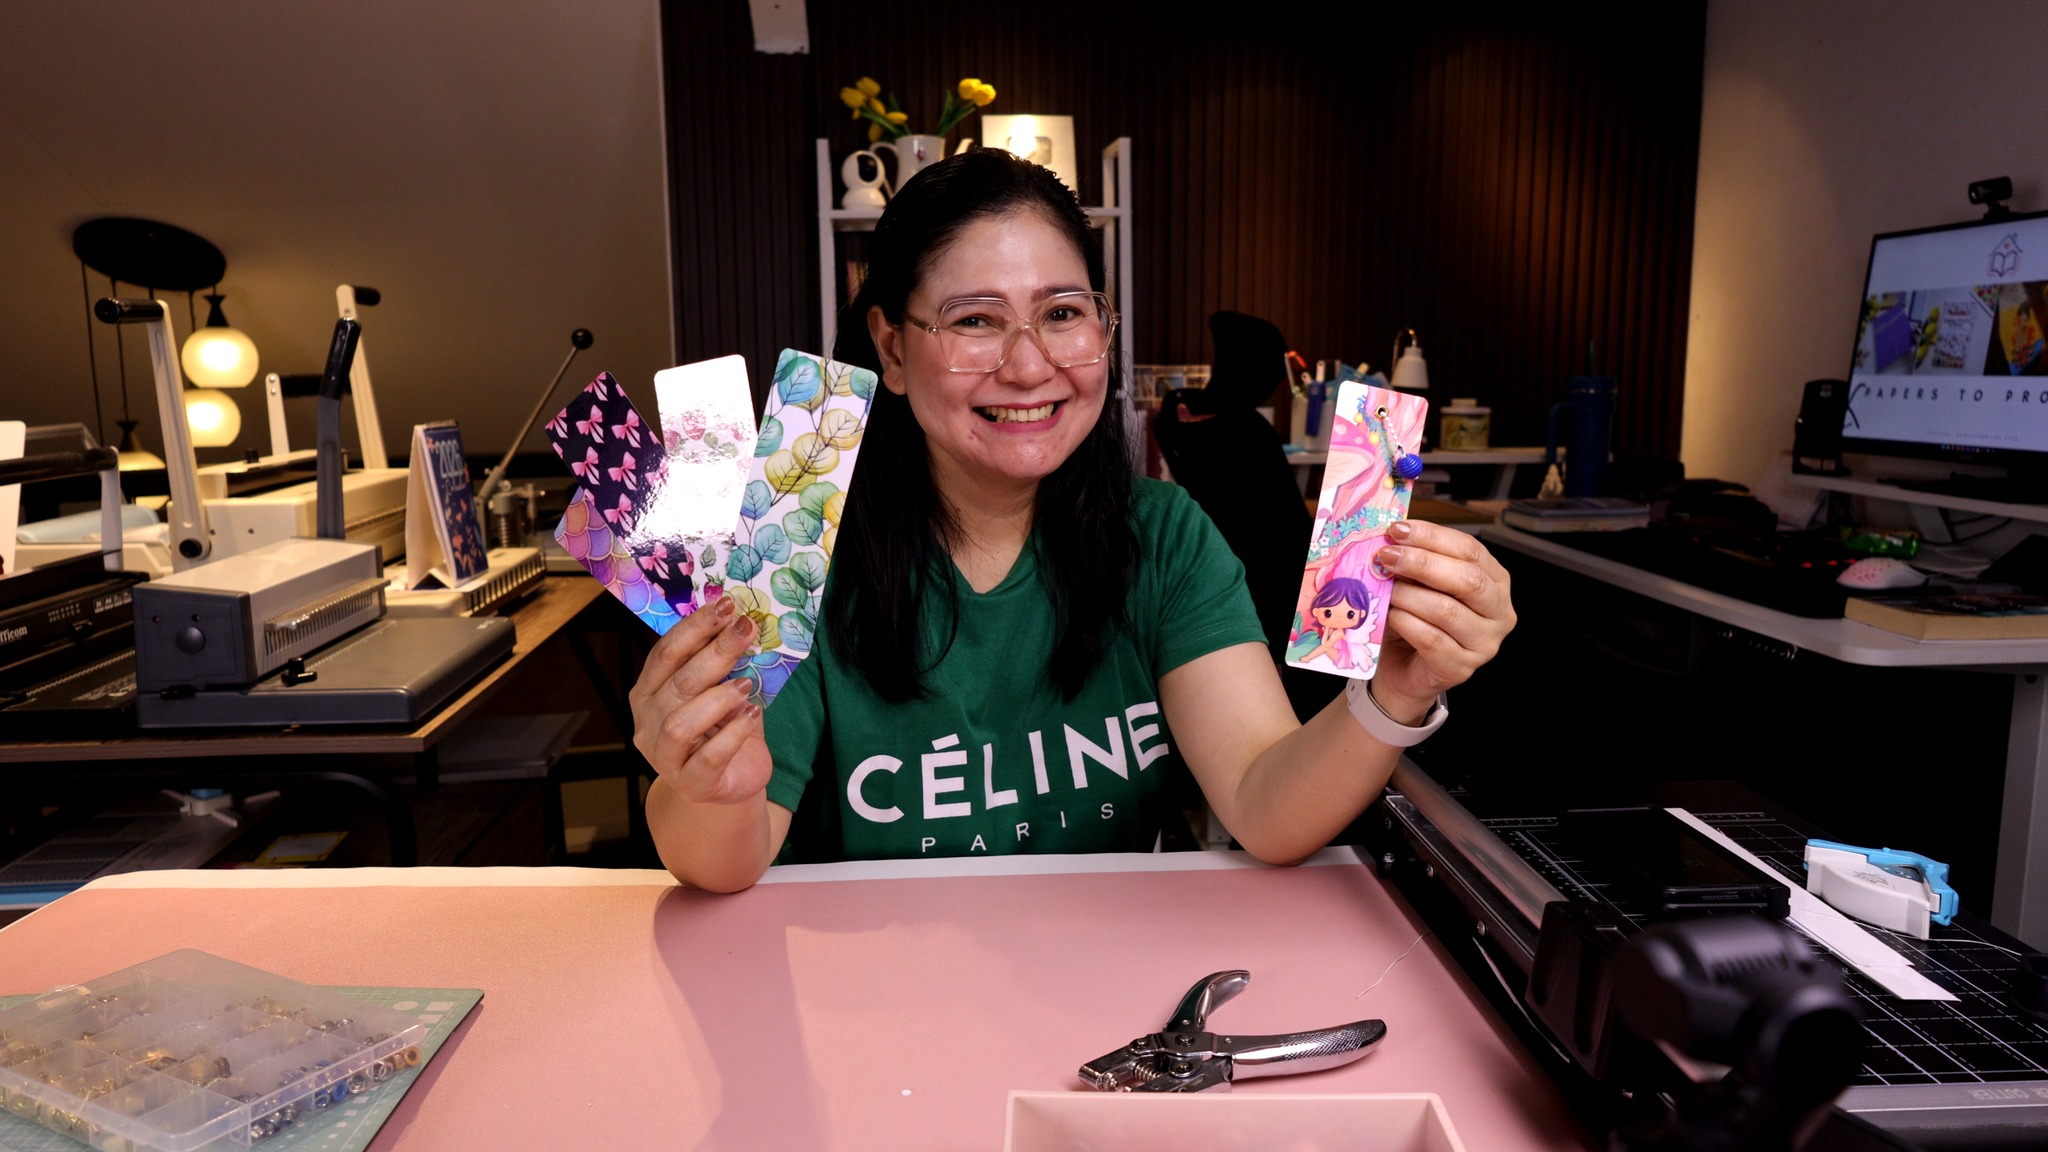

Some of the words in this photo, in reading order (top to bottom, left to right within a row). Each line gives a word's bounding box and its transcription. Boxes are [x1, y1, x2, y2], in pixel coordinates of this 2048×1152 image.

[1865, 387, 1938, 400] PAPERS
[1959, 388, 1984, 402] TO
[2005, 389, 2048, 404] PRO
[846, 701, 1170, 823] CÉLINE
[921, 803, 1114, 852] PARIS
[1967, 1088, 2030, 1100] CUTTER
